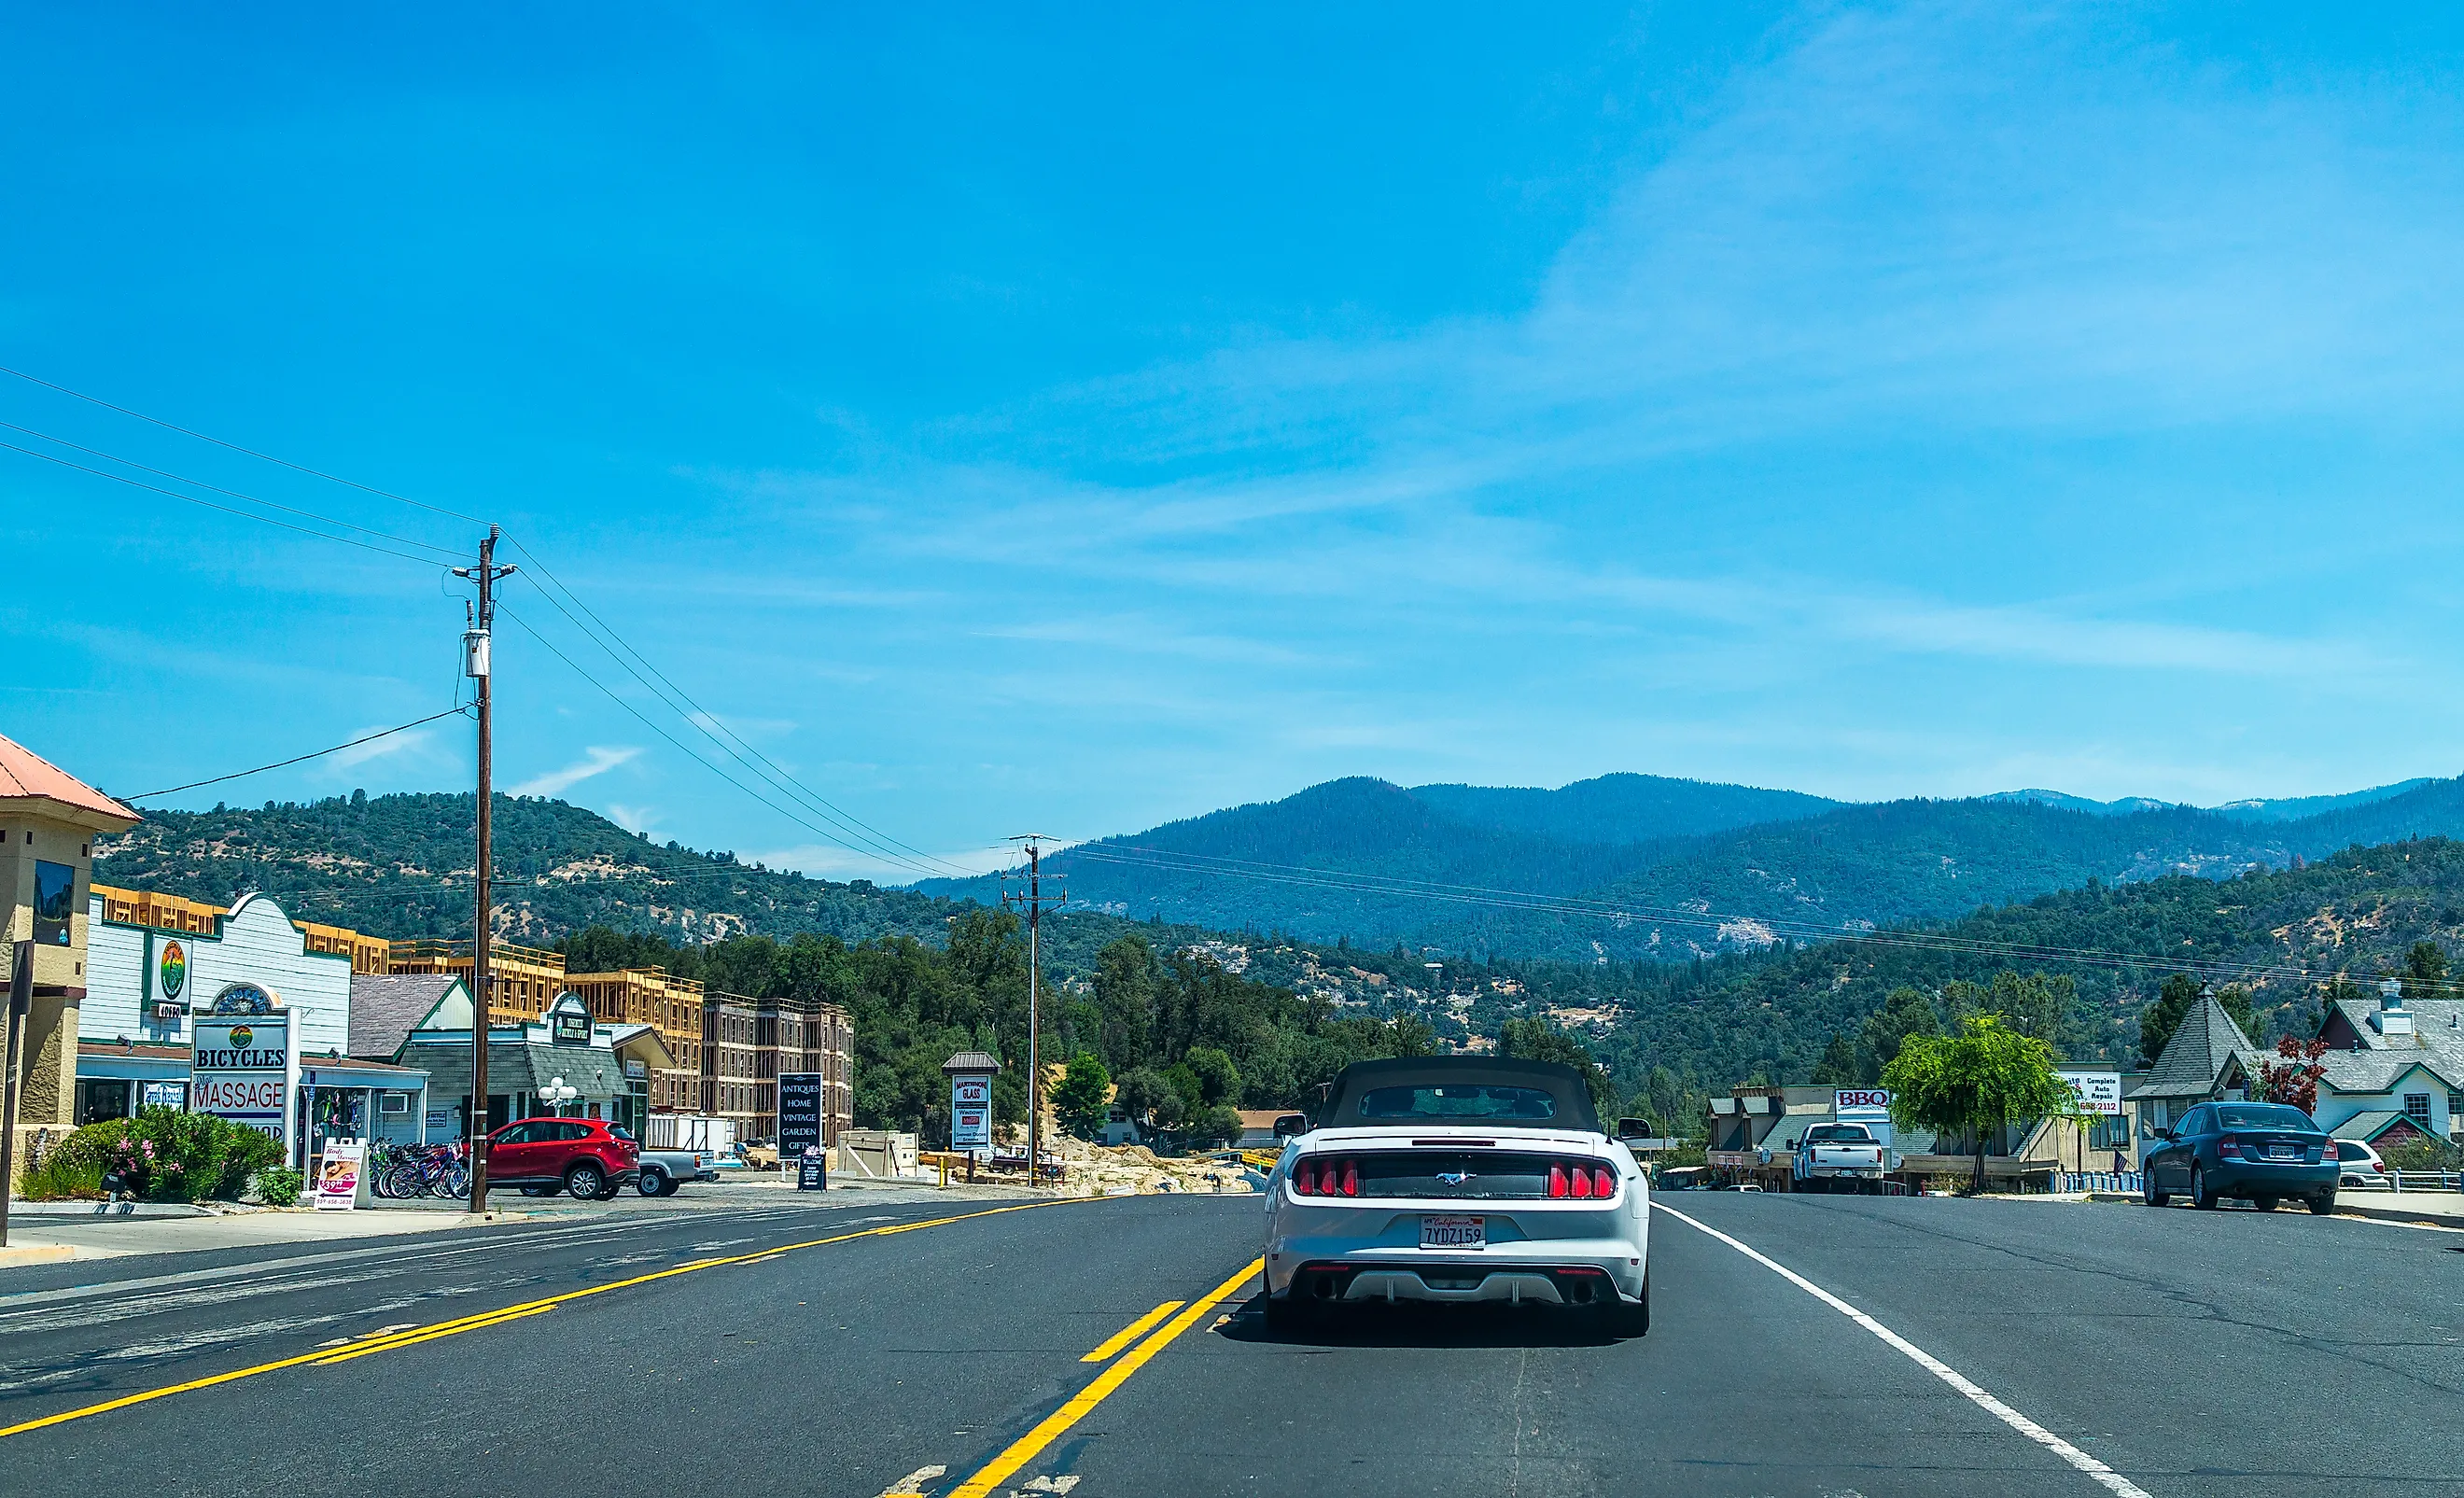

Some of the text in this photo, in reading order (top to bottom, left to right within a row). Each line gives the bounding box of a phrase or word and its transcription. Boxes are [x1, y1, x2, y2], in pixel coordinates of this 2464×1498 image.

[197, 1049, 285, 1067] BICYCLES
[2087, 1077, 2117, 1085] Complete
[193, 1083, 285, 1108] MASSAGE
[781, 1085, 819, 1095] ANTIQUES
[962, 1088, 981, 1099] GLASS
[1838, 1091, 1889, 1108] BBQ
[2091, 1092, 2114, 1100] Repair
[782, 1127, 817, 1136] GARDEN
[789, 1141, 810, 1150] GIFTS
[1434, 1217, 1474, 1228] California
[1424, 1227, 1481, 1243] 7YDZ159
